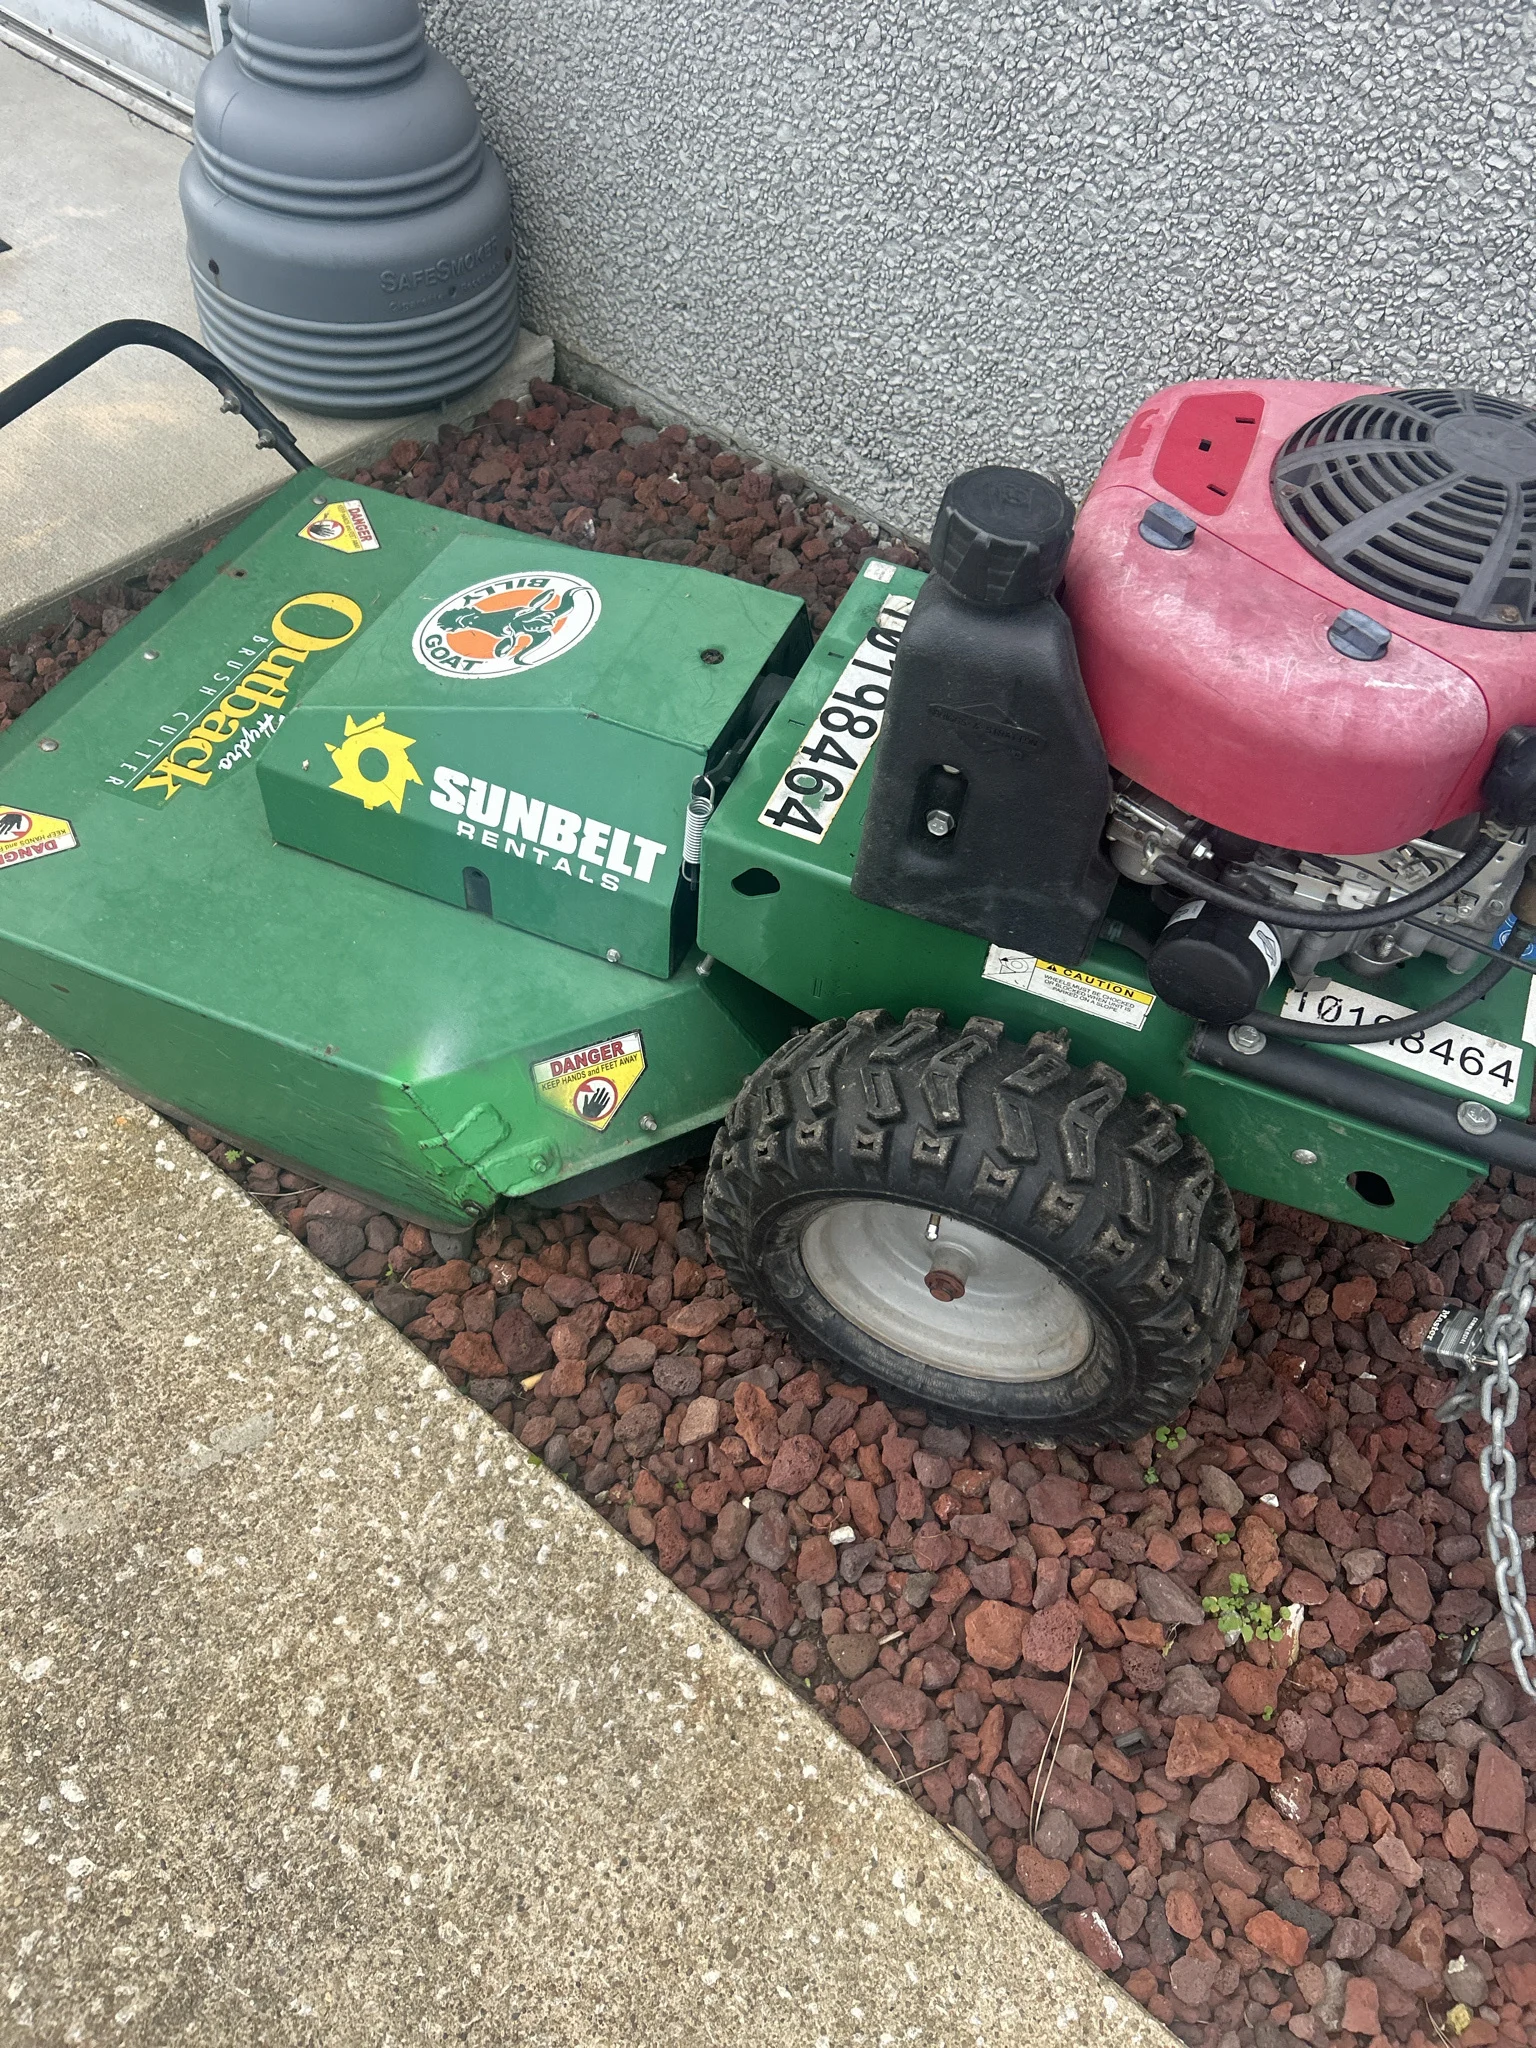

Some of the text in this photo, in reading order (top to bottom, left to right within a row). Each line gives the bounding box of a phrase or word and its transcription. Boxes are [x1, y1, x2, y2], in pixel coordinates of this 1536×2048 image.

[348, 507, 373, 542] DANGER
[463, 578, 551, 607] BILLY
[425, 633, 484, 671] GOAT
[105, 634, 269, 786] BRUSH CUTTER
[133, 592, 363, 801] Outback
[218, 713, 285, 770] Hydro
[19, 834, 46, 846] HANDS
[47, 829, 67, 838] KEEP
[430, 766, 667, 884] SUNBELT
[4, 842, 18, 850] and
[457, 820, 620, 892] RENTALS
[1044, 974, 1135, 1009] WHEELS MUST BE CHOCKED
[1052, 987, 1078, 999] PARKED
[1096, 1001, 1118, 1013] SLOPE
[1055, 983, 1086, 997] BLOCKED
[1087, 994, 1107, 1004] WHEN
[1108, 1000, 1124, 1010] UNIT
[1063, 969, 1135, 998] CAUTION
[541, 1053, 638, 1091] KEEP HANDS and FEET AWAY
[550, 1041, 625, 1077] DANGER
[1426, 1309, 1451, 1341] Master
